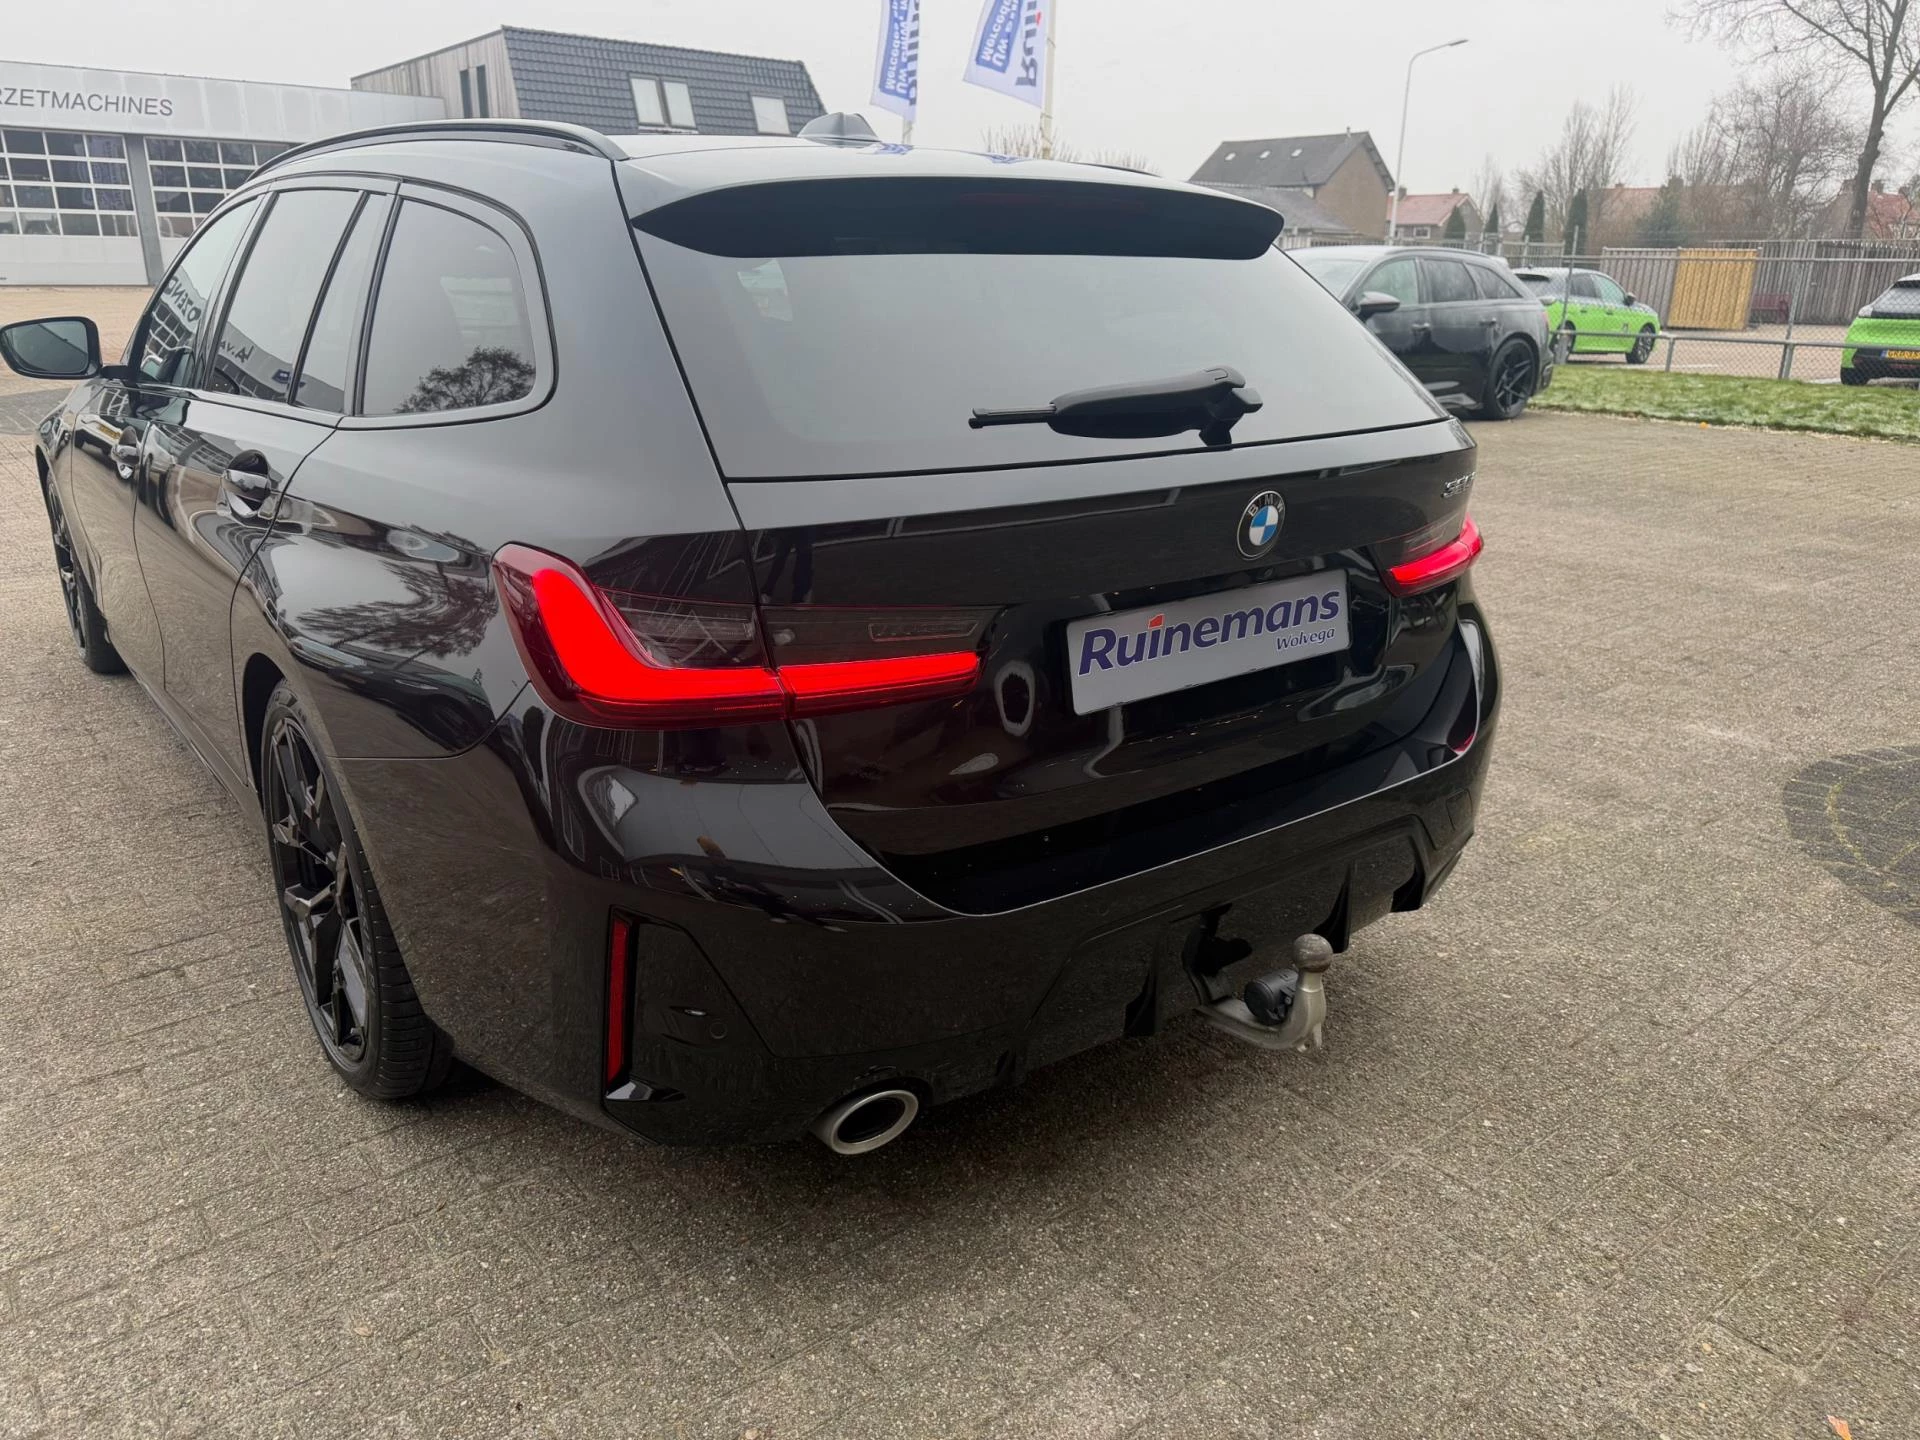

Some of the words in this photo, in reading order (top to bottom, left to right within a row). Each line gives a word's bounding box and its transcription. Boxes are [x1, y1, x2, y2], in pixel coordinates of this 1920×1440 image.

[0, 87, 173, 116] ZETMACHINES
[1247, 493, 1284, 517] BMW
[1078, 591, 1340, 676] Ruinemans
[1275, 627, 1335, 651] Wolvega
